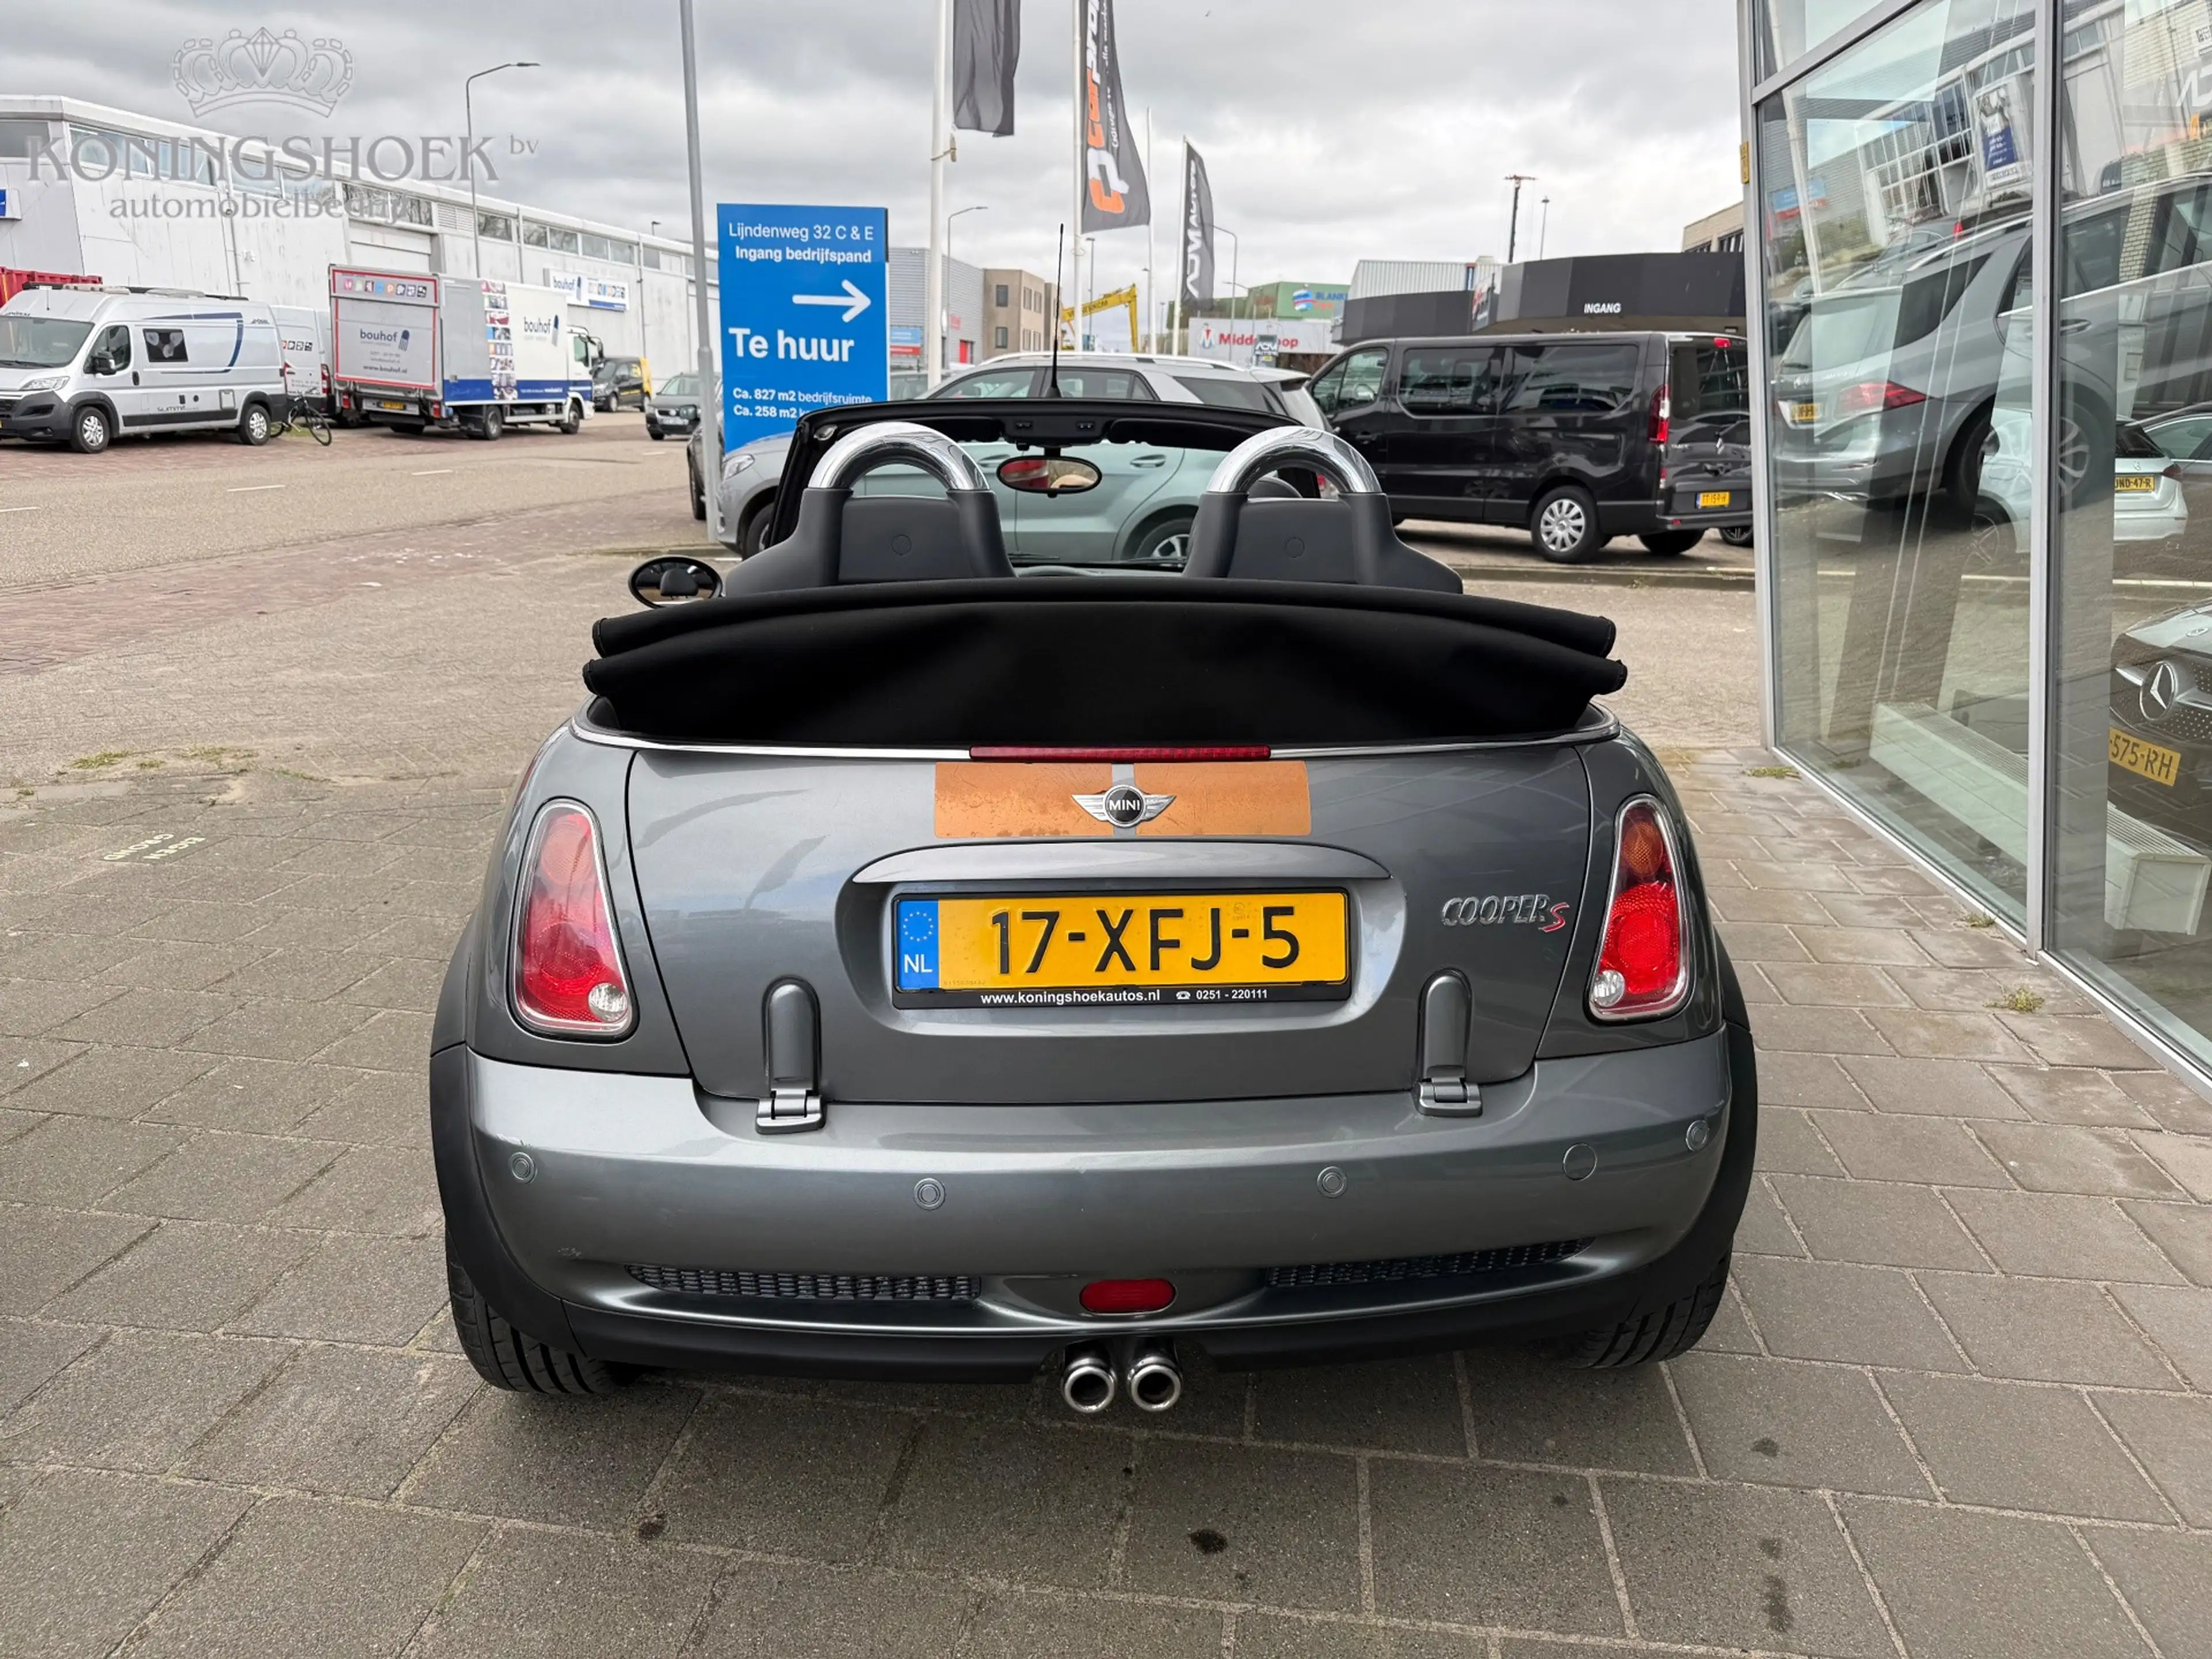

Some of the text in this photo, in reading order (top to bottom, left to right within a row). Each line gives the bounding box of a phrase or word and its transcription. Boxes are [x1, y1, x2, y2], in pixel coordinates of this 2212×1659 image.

[729, 222, 874, 242] Lijndenweg 32 C & E
[735, 245, 872, 266] Ingang bedrijfspand
[1584, 302, 1622, 314] INGANG
[524, 316, 551, 334] bouhof
[359, 328, 399, 342] bouhof
[728, 327, 855, 362] Te huur
[733, 387, 873, 406] Ca. 827 m2 bedrijfsruimte
[733, 404, 753, 417] Ca.
[755, 406, 777, 418] 258
[779, 407, 797, 419] m2
[1109, 799, 1141, 811] MINI
[1442, 893, 1570, 933] COOPER S
[991, 906, 1300, 975] 17-XFJ-5
[904, 953, 933, 974] NL
[980, 989, 1160, 1005] www.koningshoekautos.nl
[1196, 990, 1221, 1000] 0251
[1231, 988, 1268, 1000] 220111
